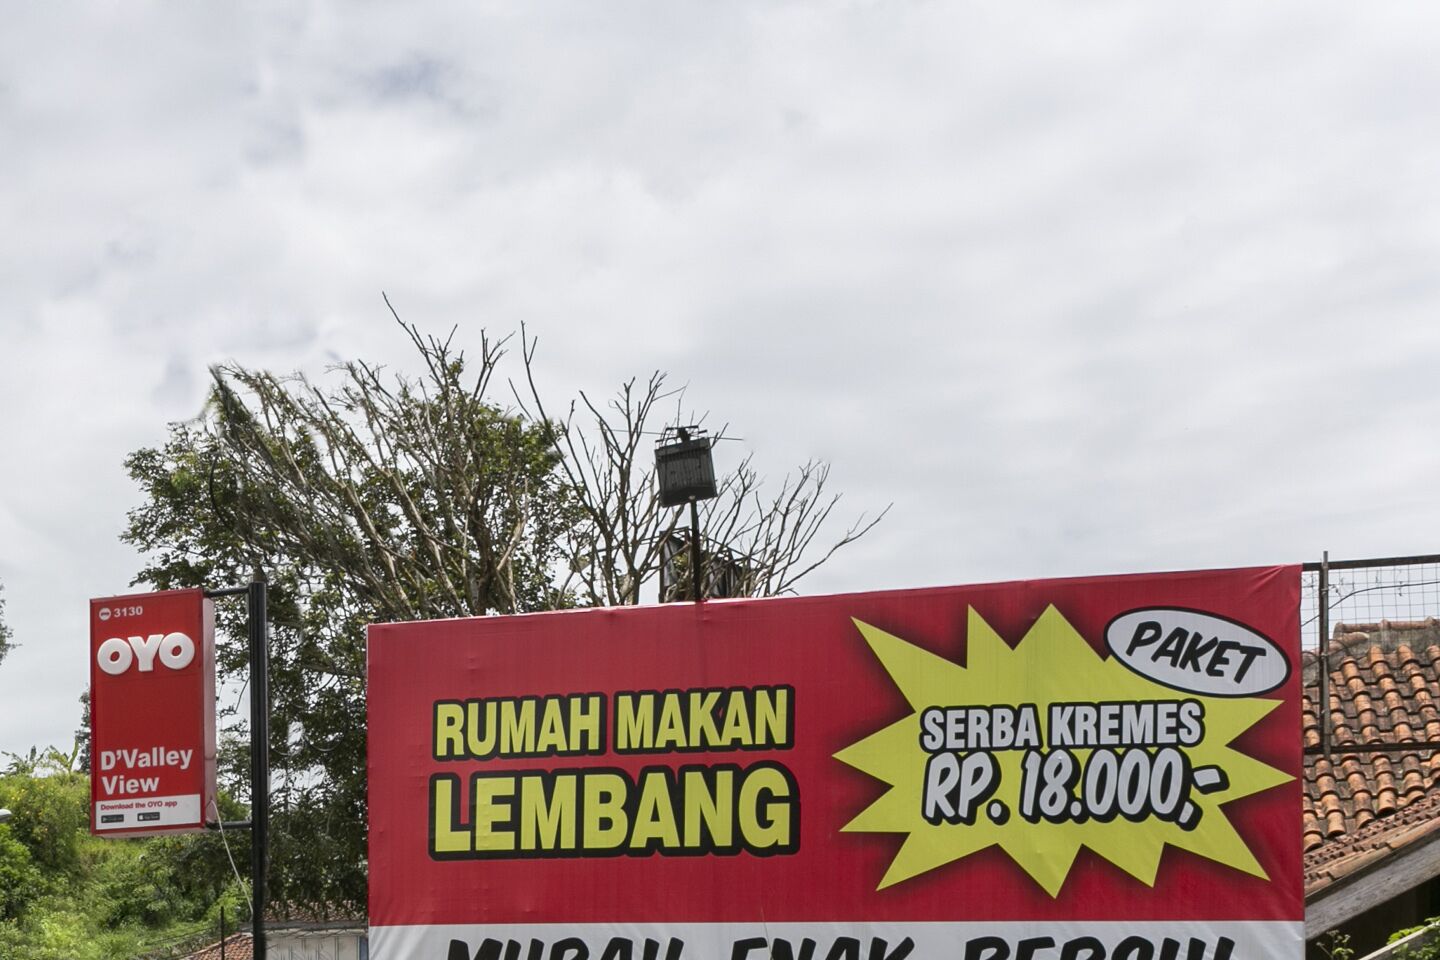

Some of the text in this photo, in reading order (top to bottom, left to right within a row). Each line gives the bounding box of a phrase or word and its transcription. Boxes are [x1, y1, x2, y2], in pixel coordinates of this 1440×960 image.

[113, 606, 143, 618] 3130
[97, 632, 195, 676] OYO
[1125, 621, 1267, 684] PAKET
[434, 688, 789, 758] RUMAH MAKAN
[922, 701, 1203, 751] SERBA KREMES
[100, 747, 193, 771] D'Valley
[100, 800, 178, 811] Download the OYO app
[101, 776, 160, 795] View
[924, 747, 1222, 825] RP. 18.000,-
[433, 766, 793, 854] LEMBANG
